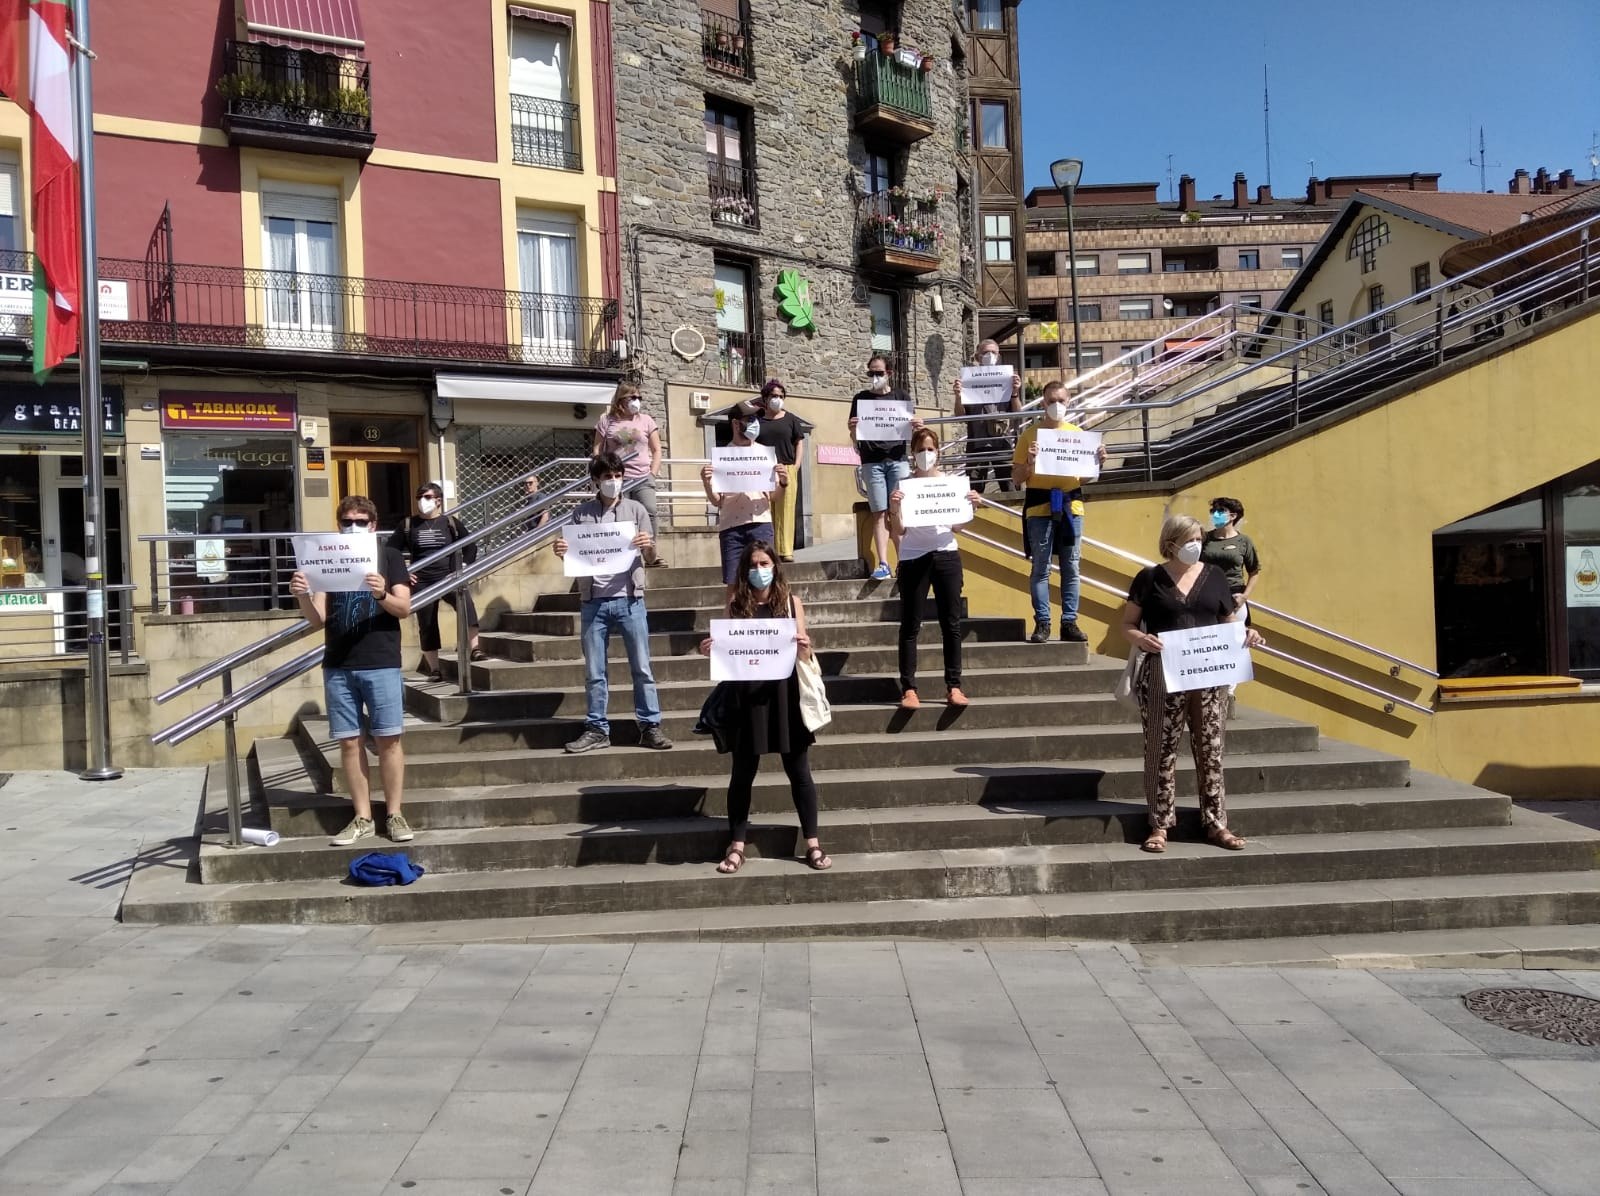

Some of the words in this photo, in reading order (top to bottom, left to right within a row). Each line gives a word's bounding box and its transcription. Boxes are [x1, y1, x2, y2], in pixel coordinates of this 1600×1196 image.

[14, 403, 113, 420] granl
[192, 402, 278, 415] TABAKOAK
[367, 429, 378, 438] 13
[920, 507, 960, 515] DESAGERTU
[578, 547, 622, 556] GEHIAGORIK
[300, 558, 334, 566] LANETIK
[728, 648, 780, 656] GEHIAGORIK
[1193, 644, 1229, 654] HILDAKO
[1187, 662, 1236, 675] DESAGERTU
